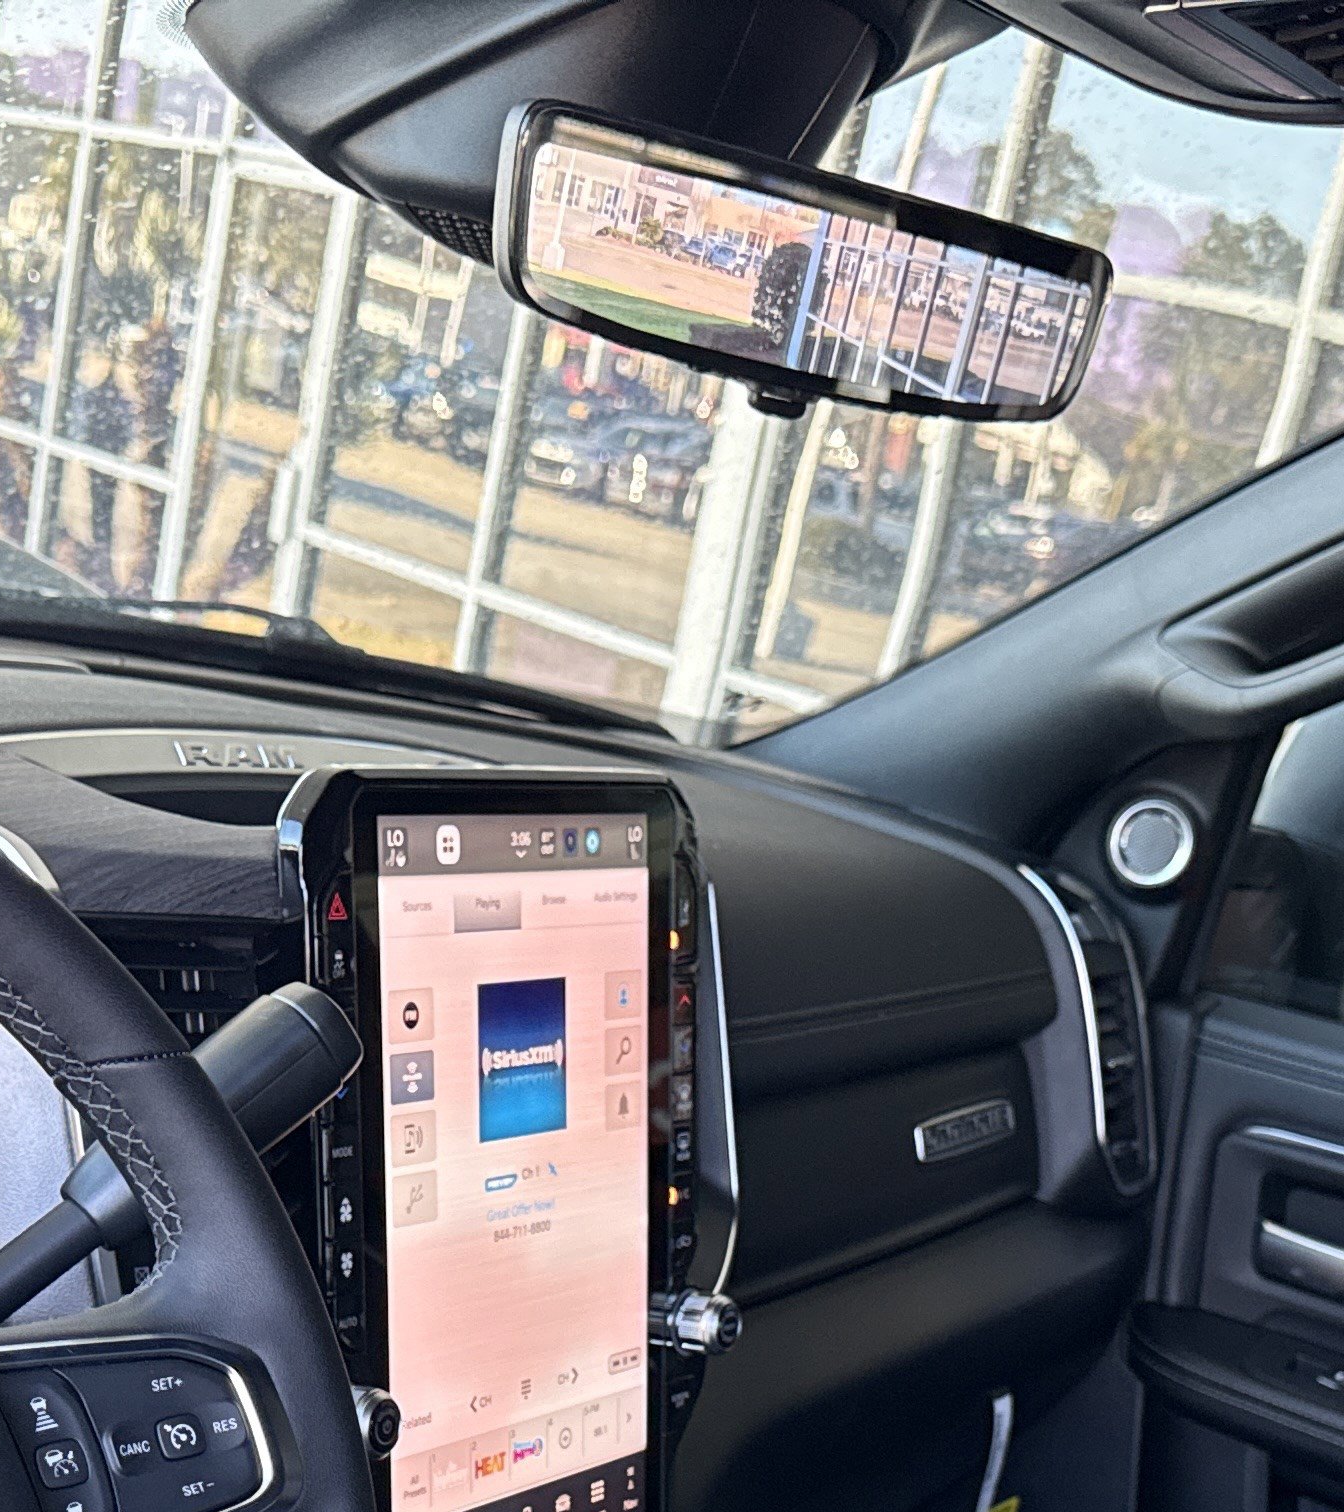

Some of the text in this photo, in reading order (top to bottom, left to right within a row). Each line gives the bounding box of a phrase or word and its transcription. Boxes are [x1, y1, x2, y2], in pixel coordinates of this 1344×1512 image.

[173, 740, 302, 770] RAM
[212, 1416, 238, 1434] RES
[119, 1440, 151, 1457] CANC
[475, 1452, 506, 1480] HEAT
